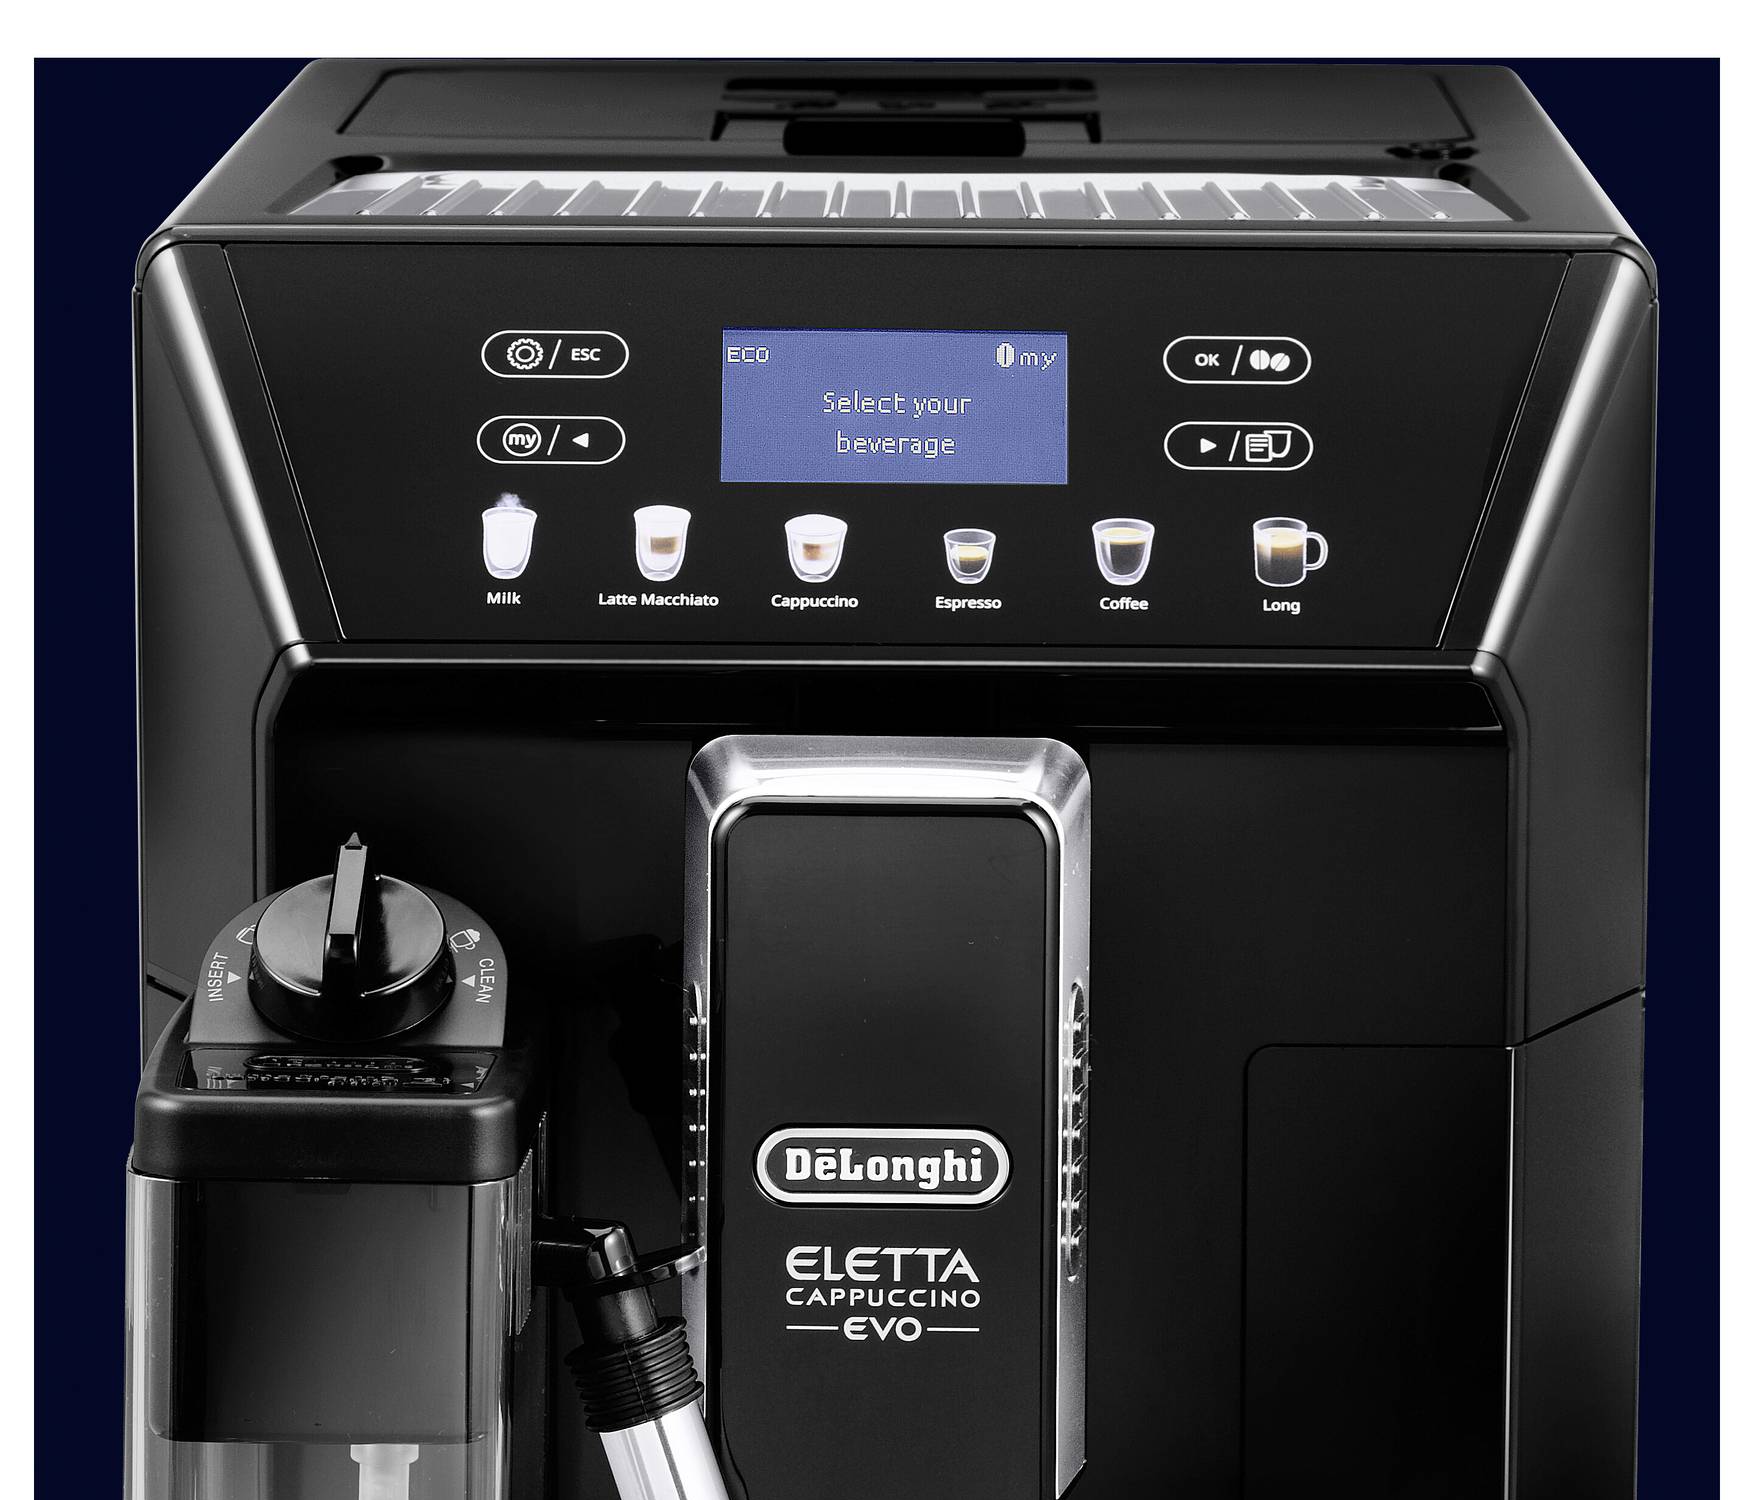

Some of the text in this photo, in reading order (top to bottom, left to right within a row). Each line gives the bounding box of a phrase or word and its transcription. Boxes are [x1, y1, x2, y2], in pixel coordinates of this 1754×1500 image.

[570, 347, 602, 362] ESC
[727, 346, 770, 363] ECO
[1019, 350, 1058, 371] my
[1194, 353, 1220, 367] OK
[822, 389, 972, 419] Select your
[508, 432, 537, 449] my
[836, 430, 955, 459] beverage
[486, 591, 522, 605] Milk
[598, 592, 720, 607] Latte Macchiato
[770, 594, 859, 611] Cappuccino
[935, 595, 1003, 612] Espresso
[1099, 596, 1149, 611] Coffee
[1262, 598, 1301, 615] Long
[206, 951, 229, 1002] INSERT
[475, 957, 496, 1004] CLEAN
[785, 1245, 980, 1283] ELETTA
[785, 1287, 981, 1308] CAPPUCCINO
[843, 1316, 923, 1342] EVO
